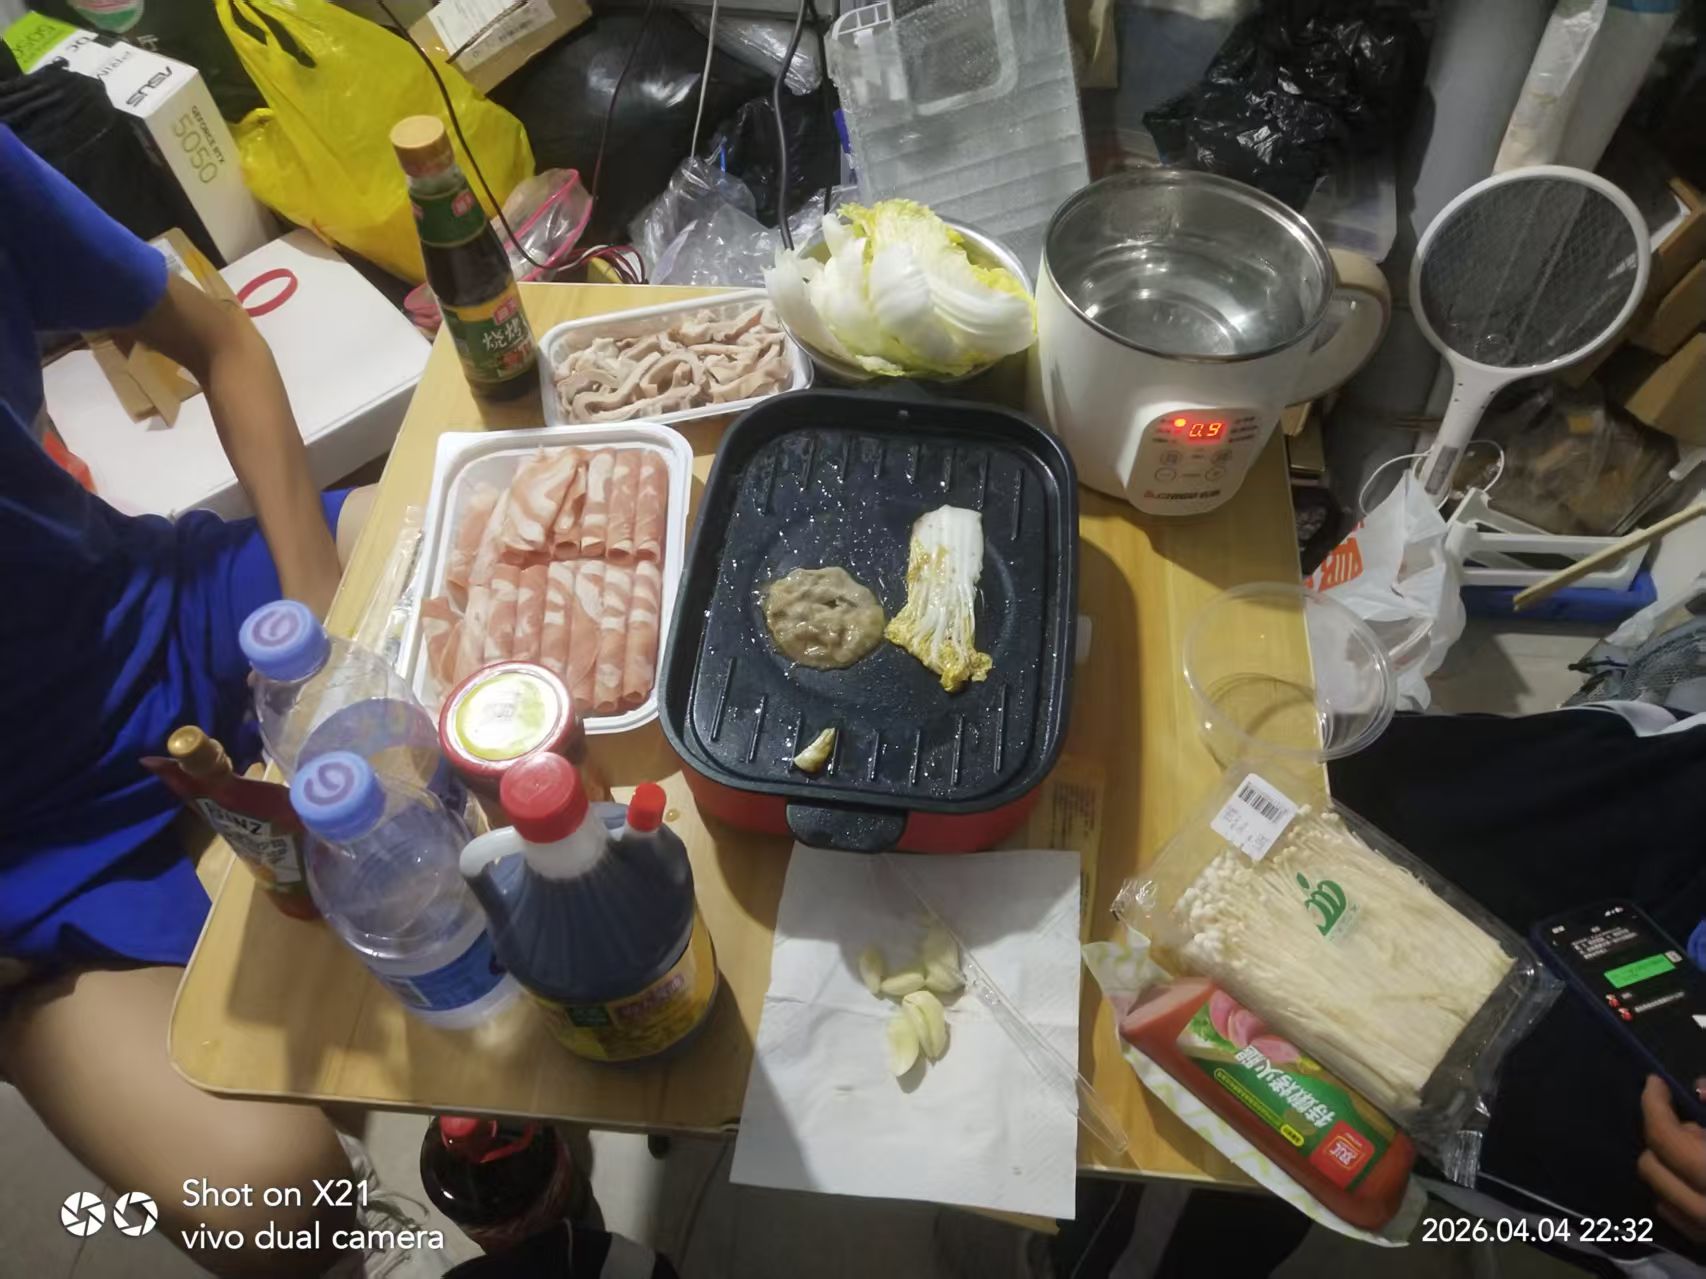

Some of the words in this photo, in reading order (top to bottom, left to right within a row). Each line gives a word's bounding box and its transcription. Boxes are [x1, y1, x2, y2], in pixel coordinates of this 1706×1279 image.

[126, 66, 172, 107] ASUS
[192, 105, 216, 146] GEFORCE
[173, 113, 218, 183] 5050
[1235, 1045, 1336, 1128] 特嫩烤火腿
[1329, 1140, 1359, 1165] 双汇
